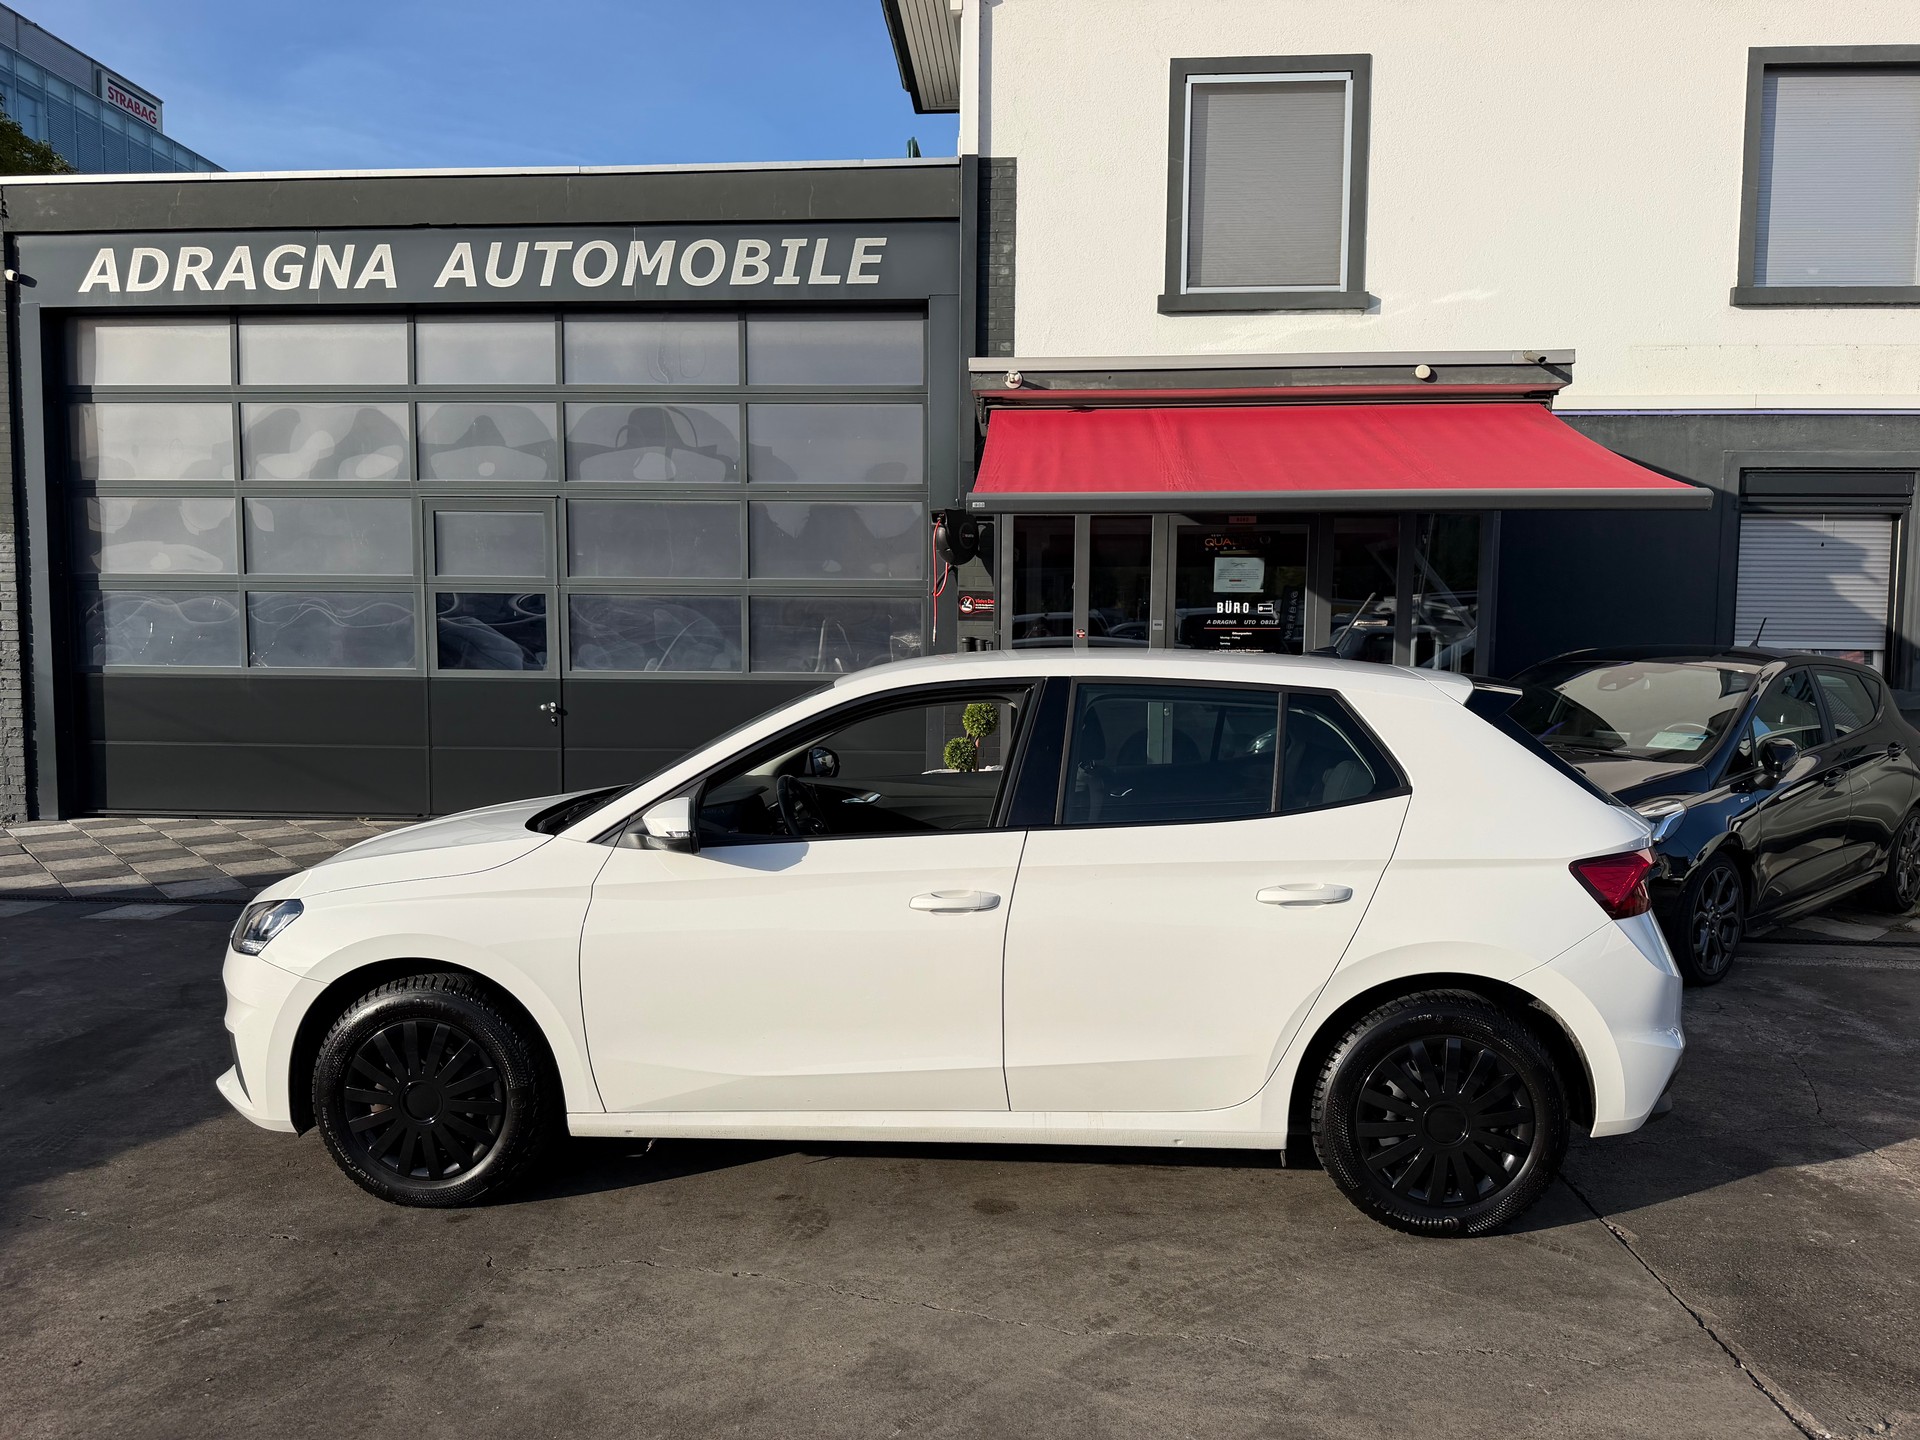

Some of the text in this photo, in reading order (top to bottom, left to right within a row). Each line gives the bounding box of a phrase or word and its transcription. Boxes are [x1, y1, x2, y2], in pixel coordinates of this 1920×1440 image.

[108, 86, 157, 124] STRABAG
[78, 237, 888, 293] ADRAGNA AUTOMOBILE
[1217, 600, 1250, 614] BÜRO
